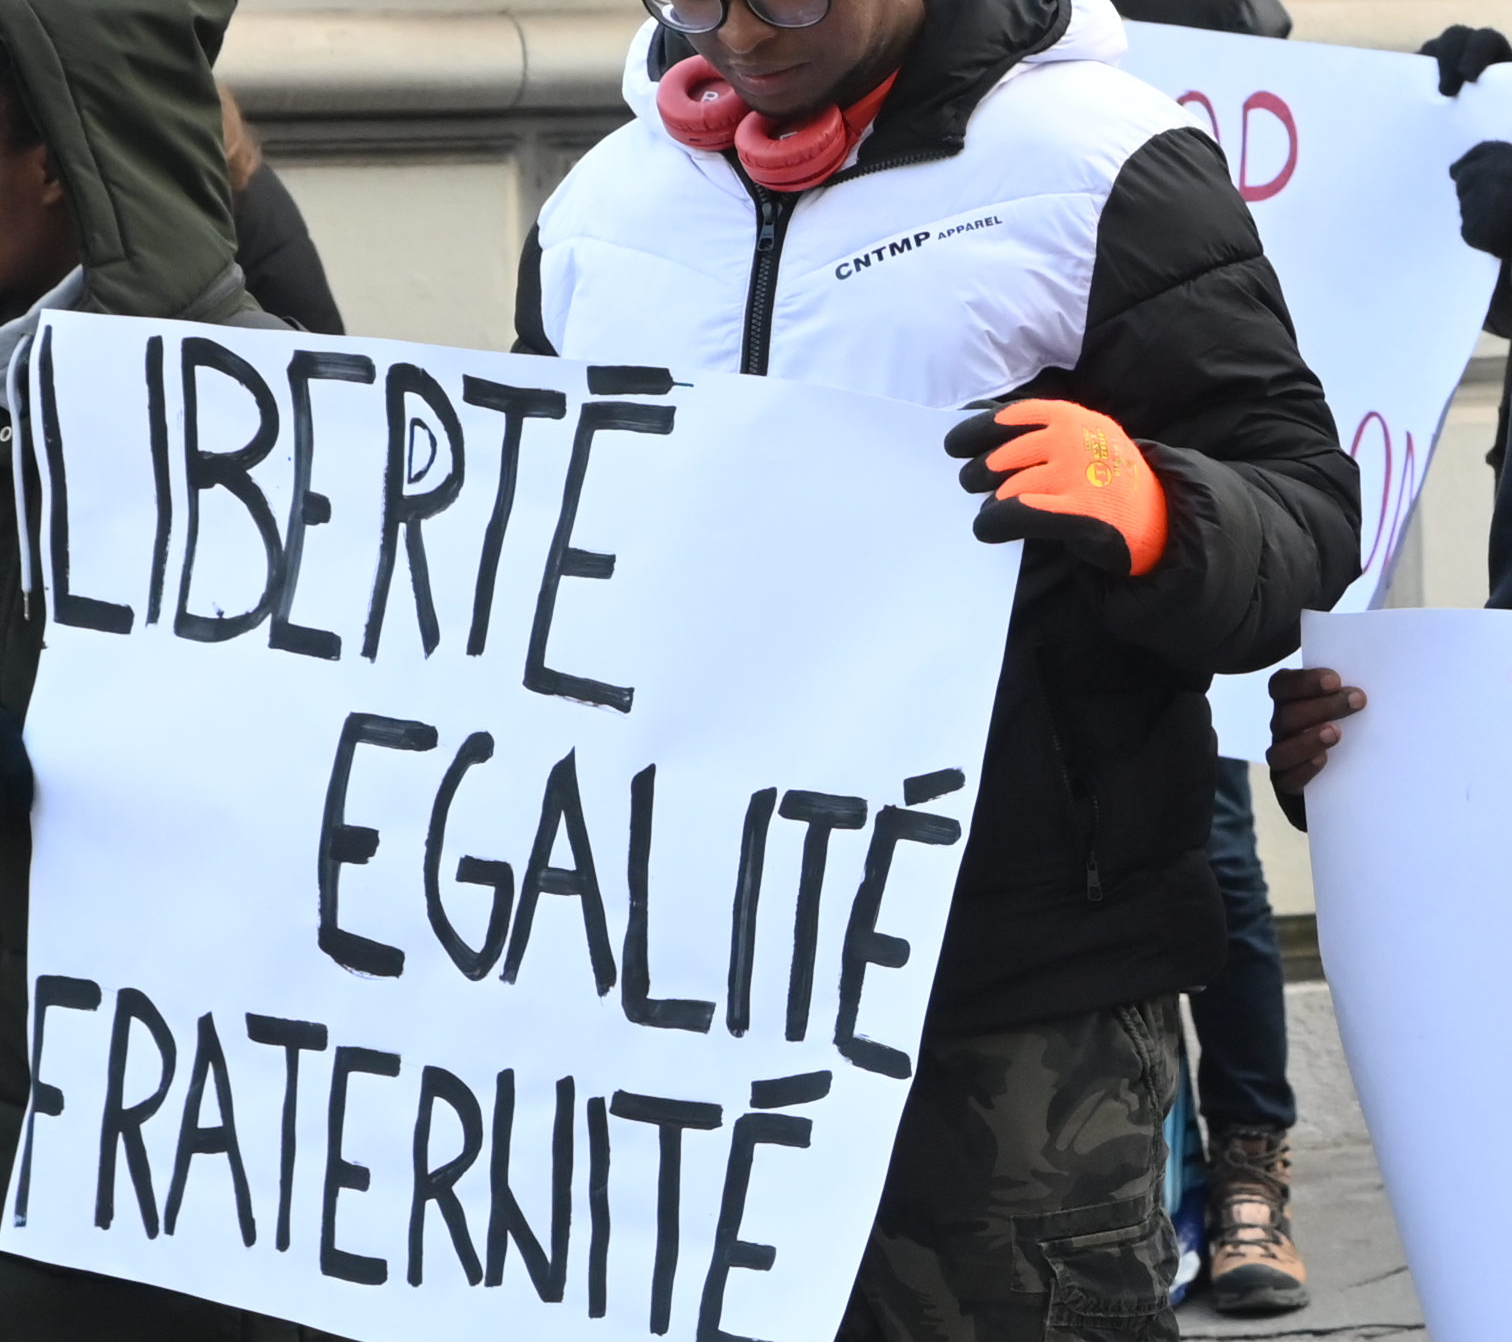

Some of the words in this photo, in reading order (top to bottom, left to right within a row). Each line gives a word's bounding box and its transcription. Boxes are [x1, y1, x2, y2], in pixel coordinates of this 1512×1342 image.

[835, 230, 931, 280] CNTMP
[937, 215, 1004, 240] APPAREL
[41, 324, 680, 714] LIBERTÉ
[317, 711, 966, 1080] EGALITÉ
